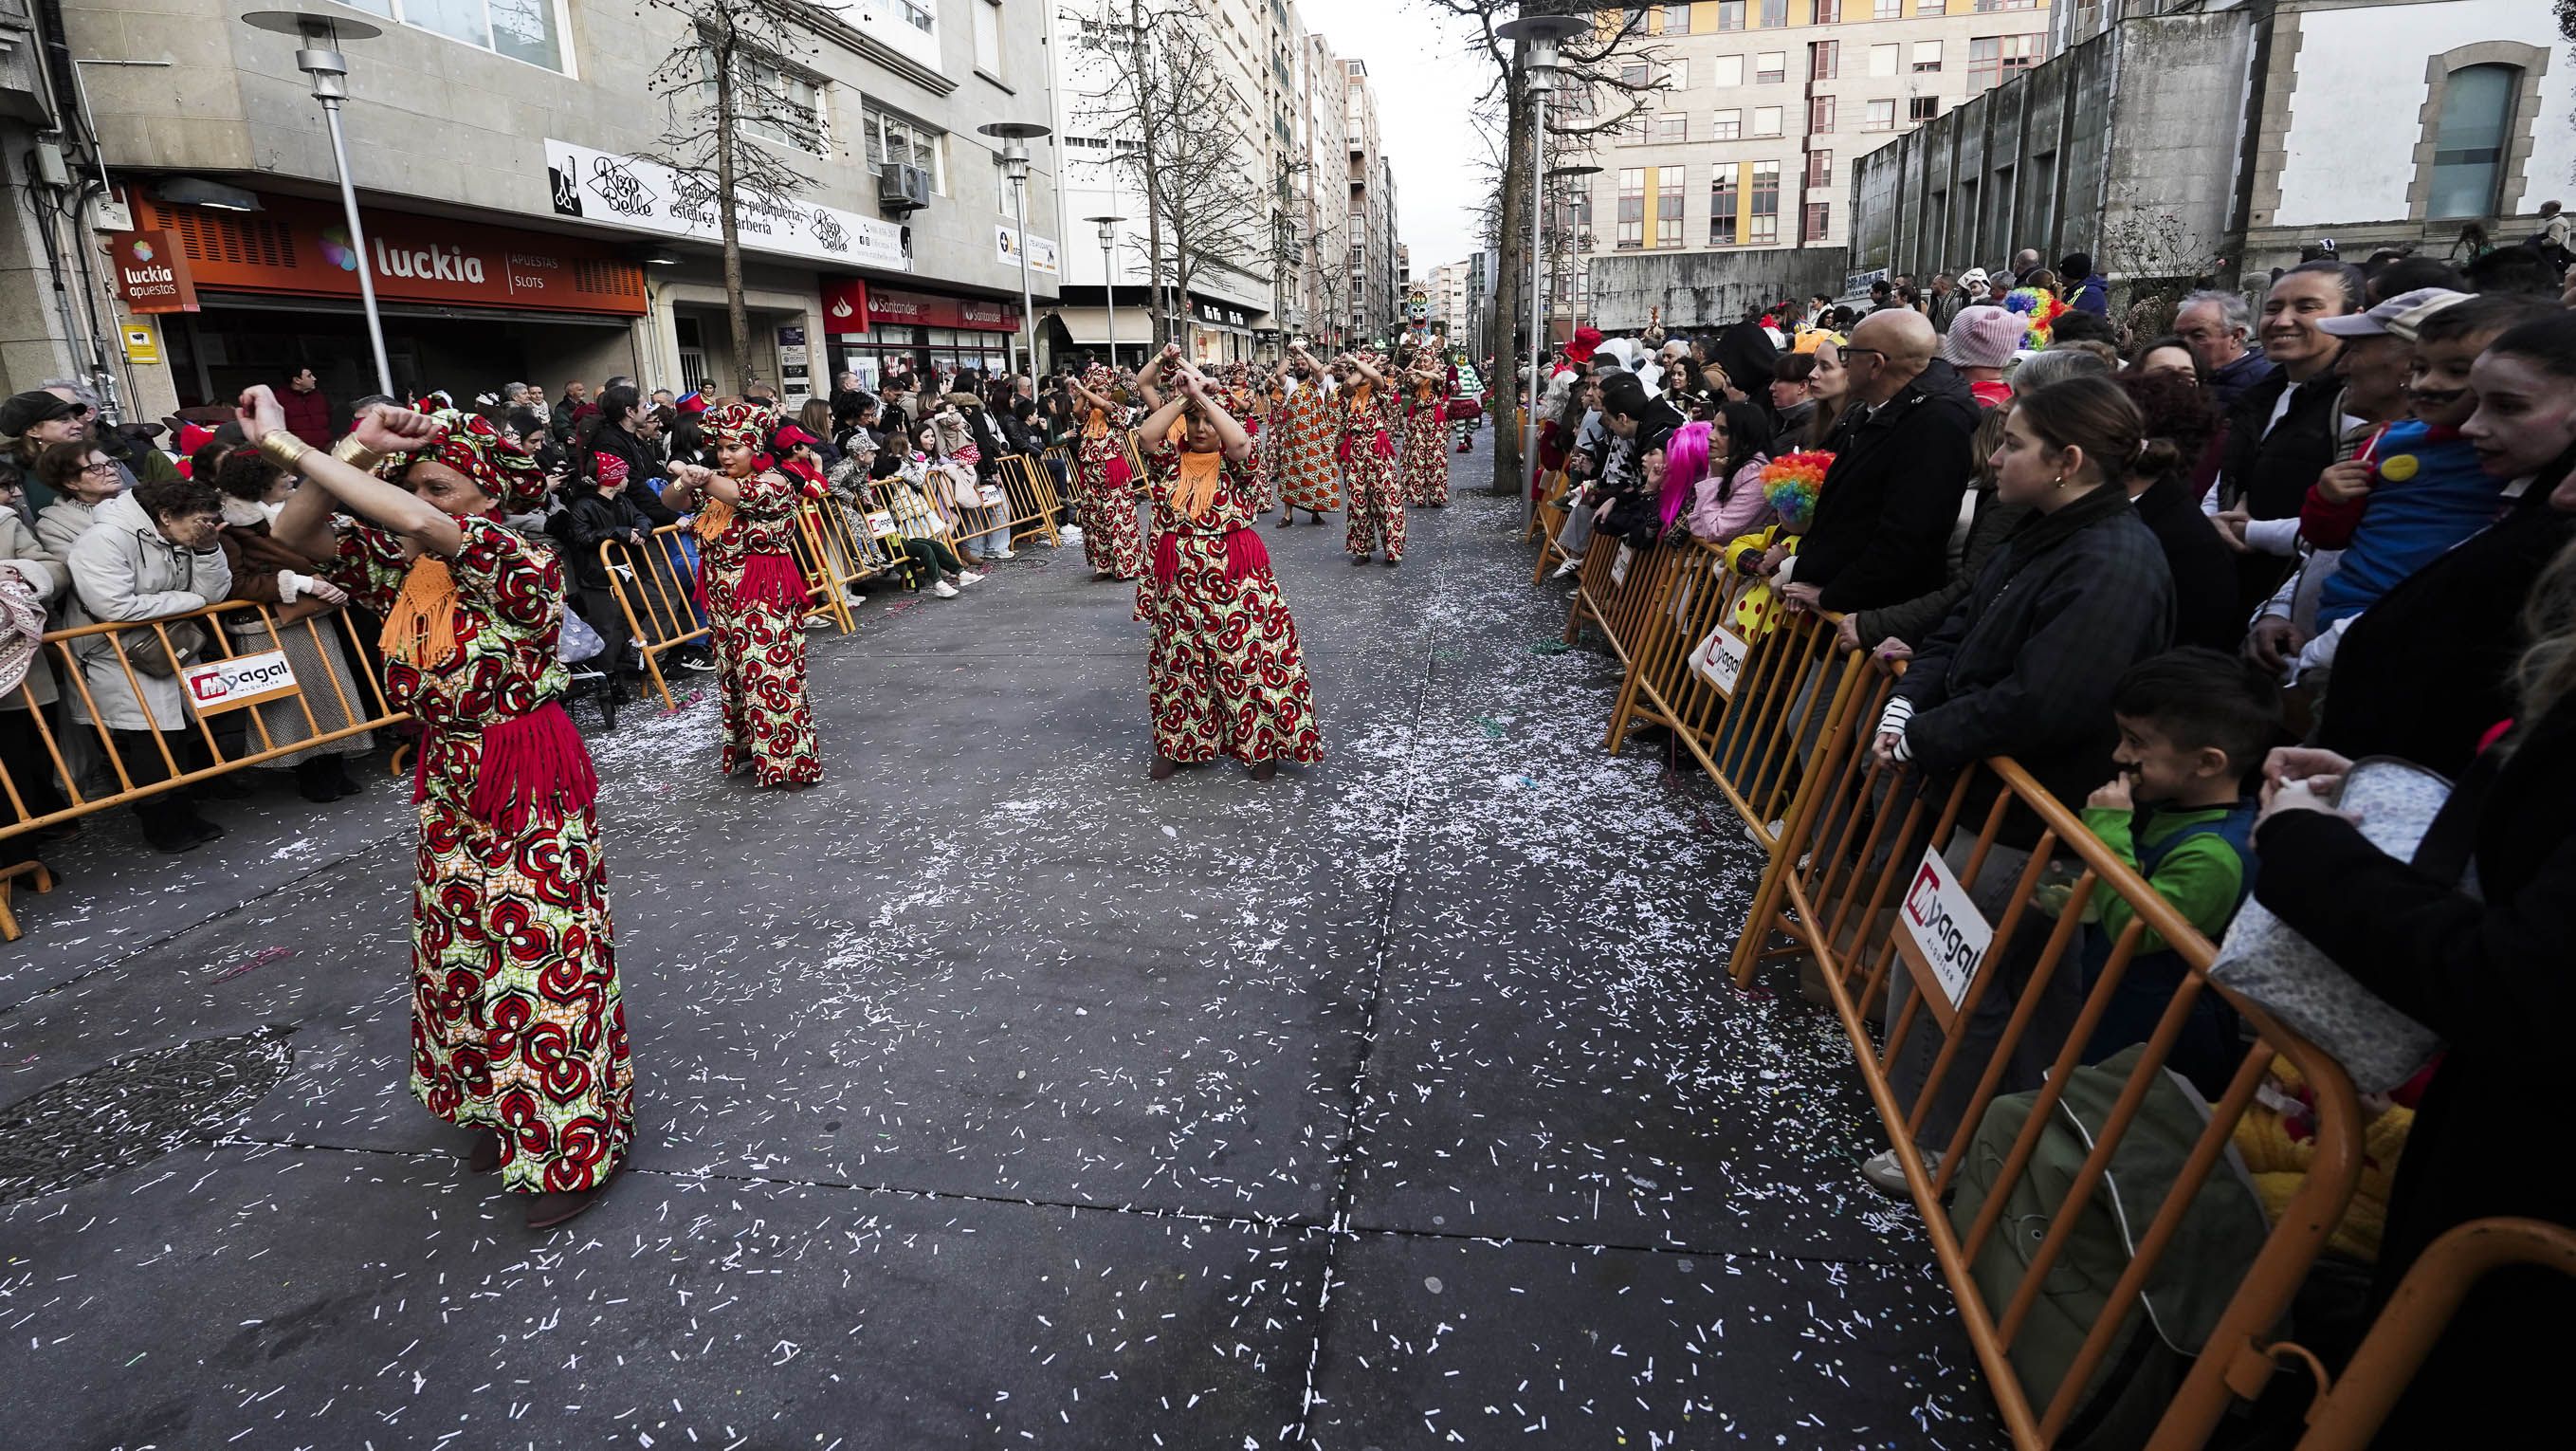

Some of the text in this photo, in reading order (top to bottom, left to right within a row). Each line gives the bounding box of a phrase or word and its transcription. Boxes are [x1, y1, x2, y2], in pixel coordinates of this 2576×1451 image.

[594, 156, 639, 197] Rizo
[602, 186, 654, 216] Belle
[671, 178, 720, 204] Academ
[735, 214, 772, 235] arbería
[819, 230, 849, 252] Belle
[375, 237, 558, 283] luckia APUESTAS
[125, 266, 173, 285] luckia
[515, 275, 544, 288] SLOTS
[129, 283, 176, 300] apuestas
[879, 298, 1001, 323] Santander Santander
[192, 661, 287, 700] Myagal
[1908, 862, 1980, 978] Myagal
[1927, 938, 1954, 983] ALQUILER
